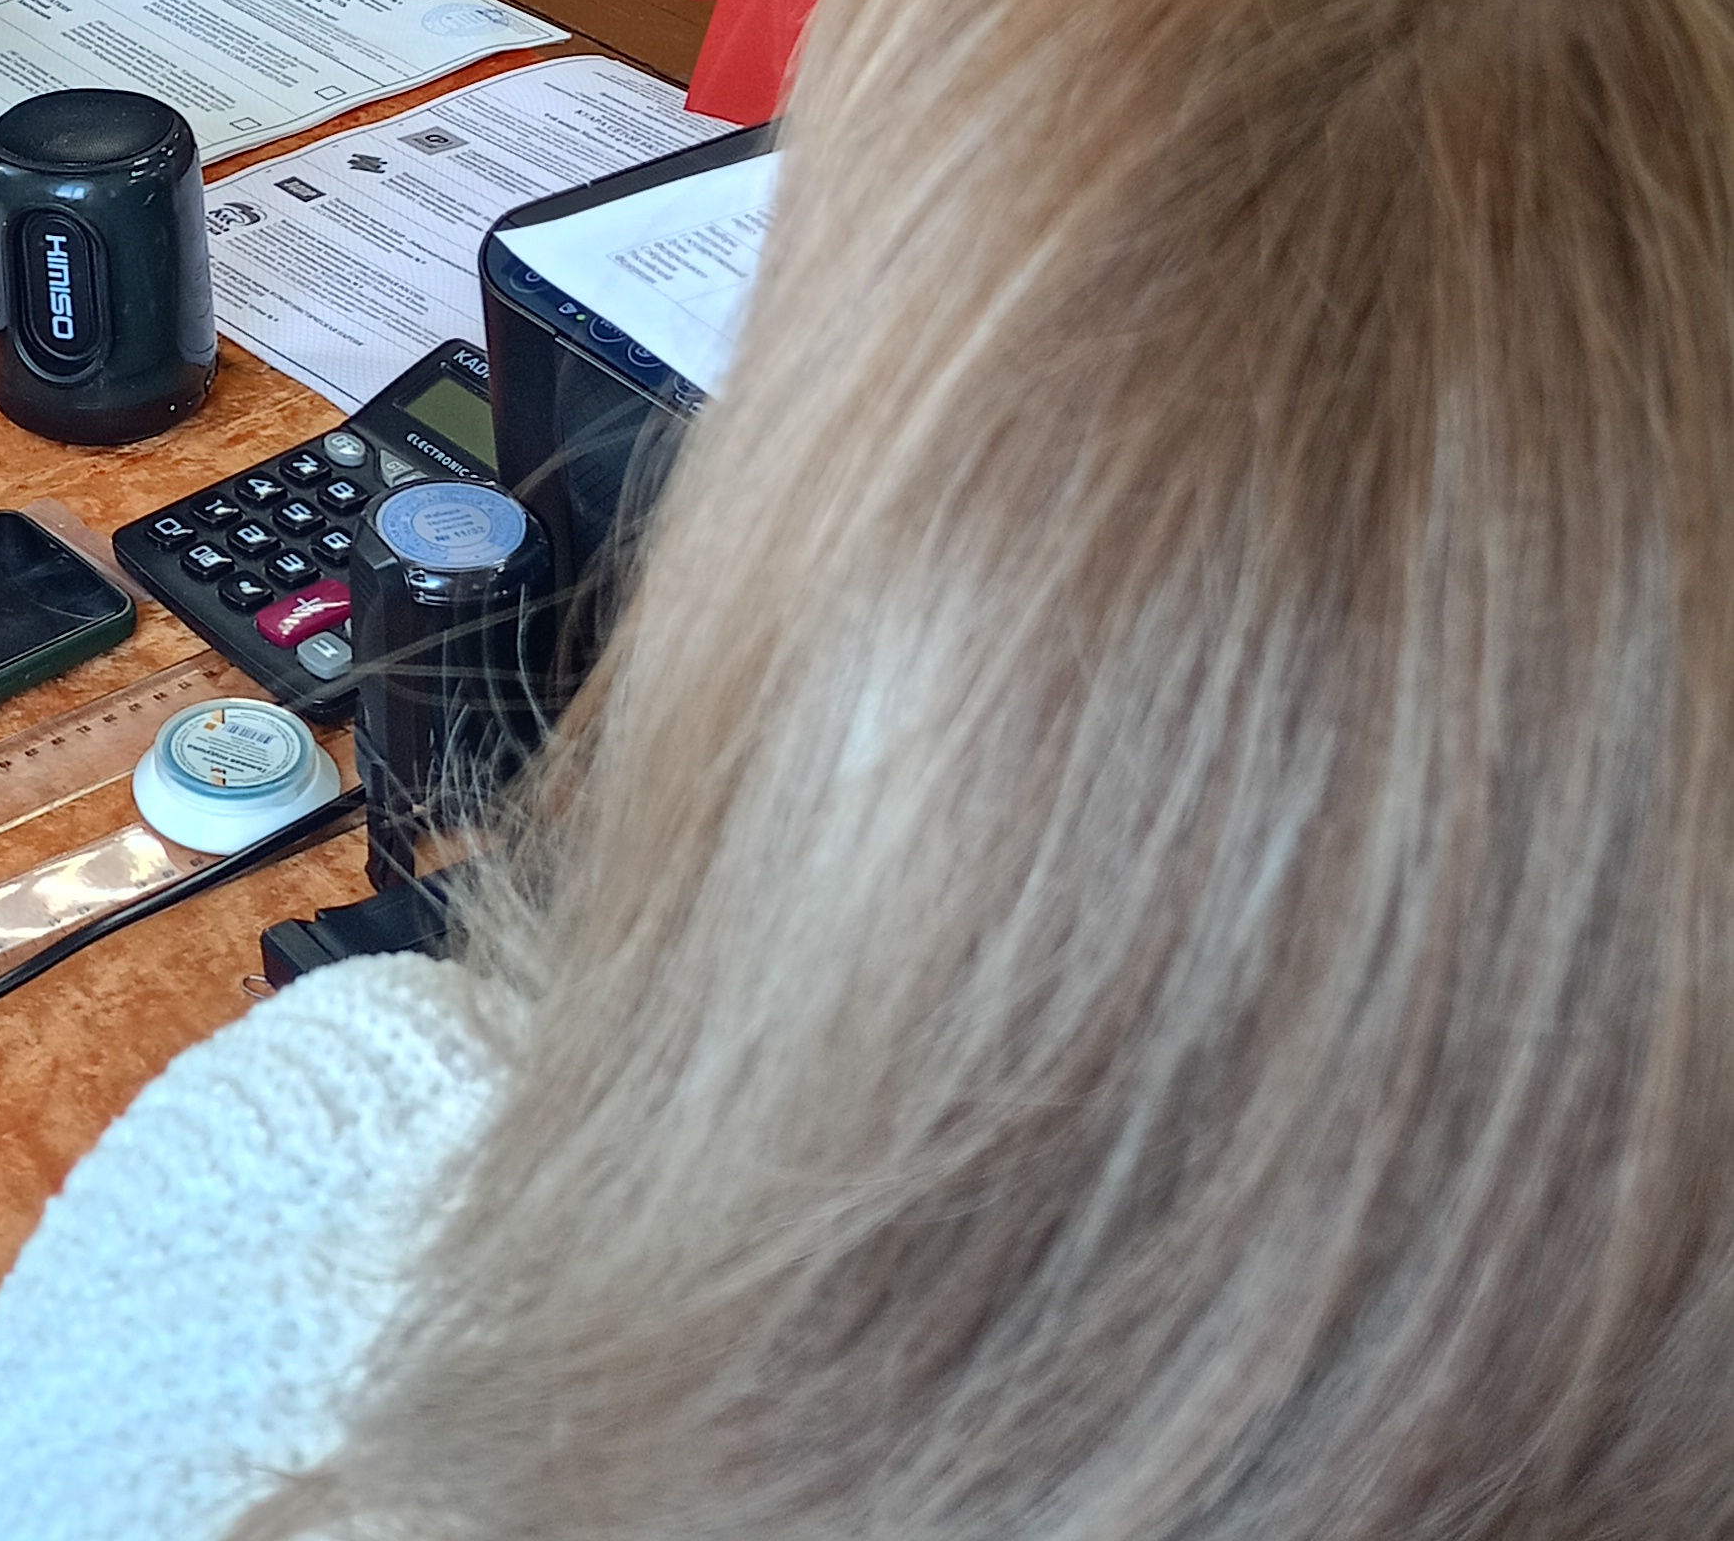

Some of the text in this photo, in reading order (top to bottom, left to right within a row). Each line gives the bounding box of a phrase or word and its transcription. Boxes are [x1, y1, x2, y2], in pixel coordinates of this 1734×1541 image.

[406, 432, 470, 477] ELECTRONIC
[247, 477, 273, 499] 4
[327, 481, 354, 500] 8
[282, 502, 311, 521] 5
[237, 526, 266, 545] 2
[323, 531, 351, 550] 6
[276, 553, 306, 572] 3
